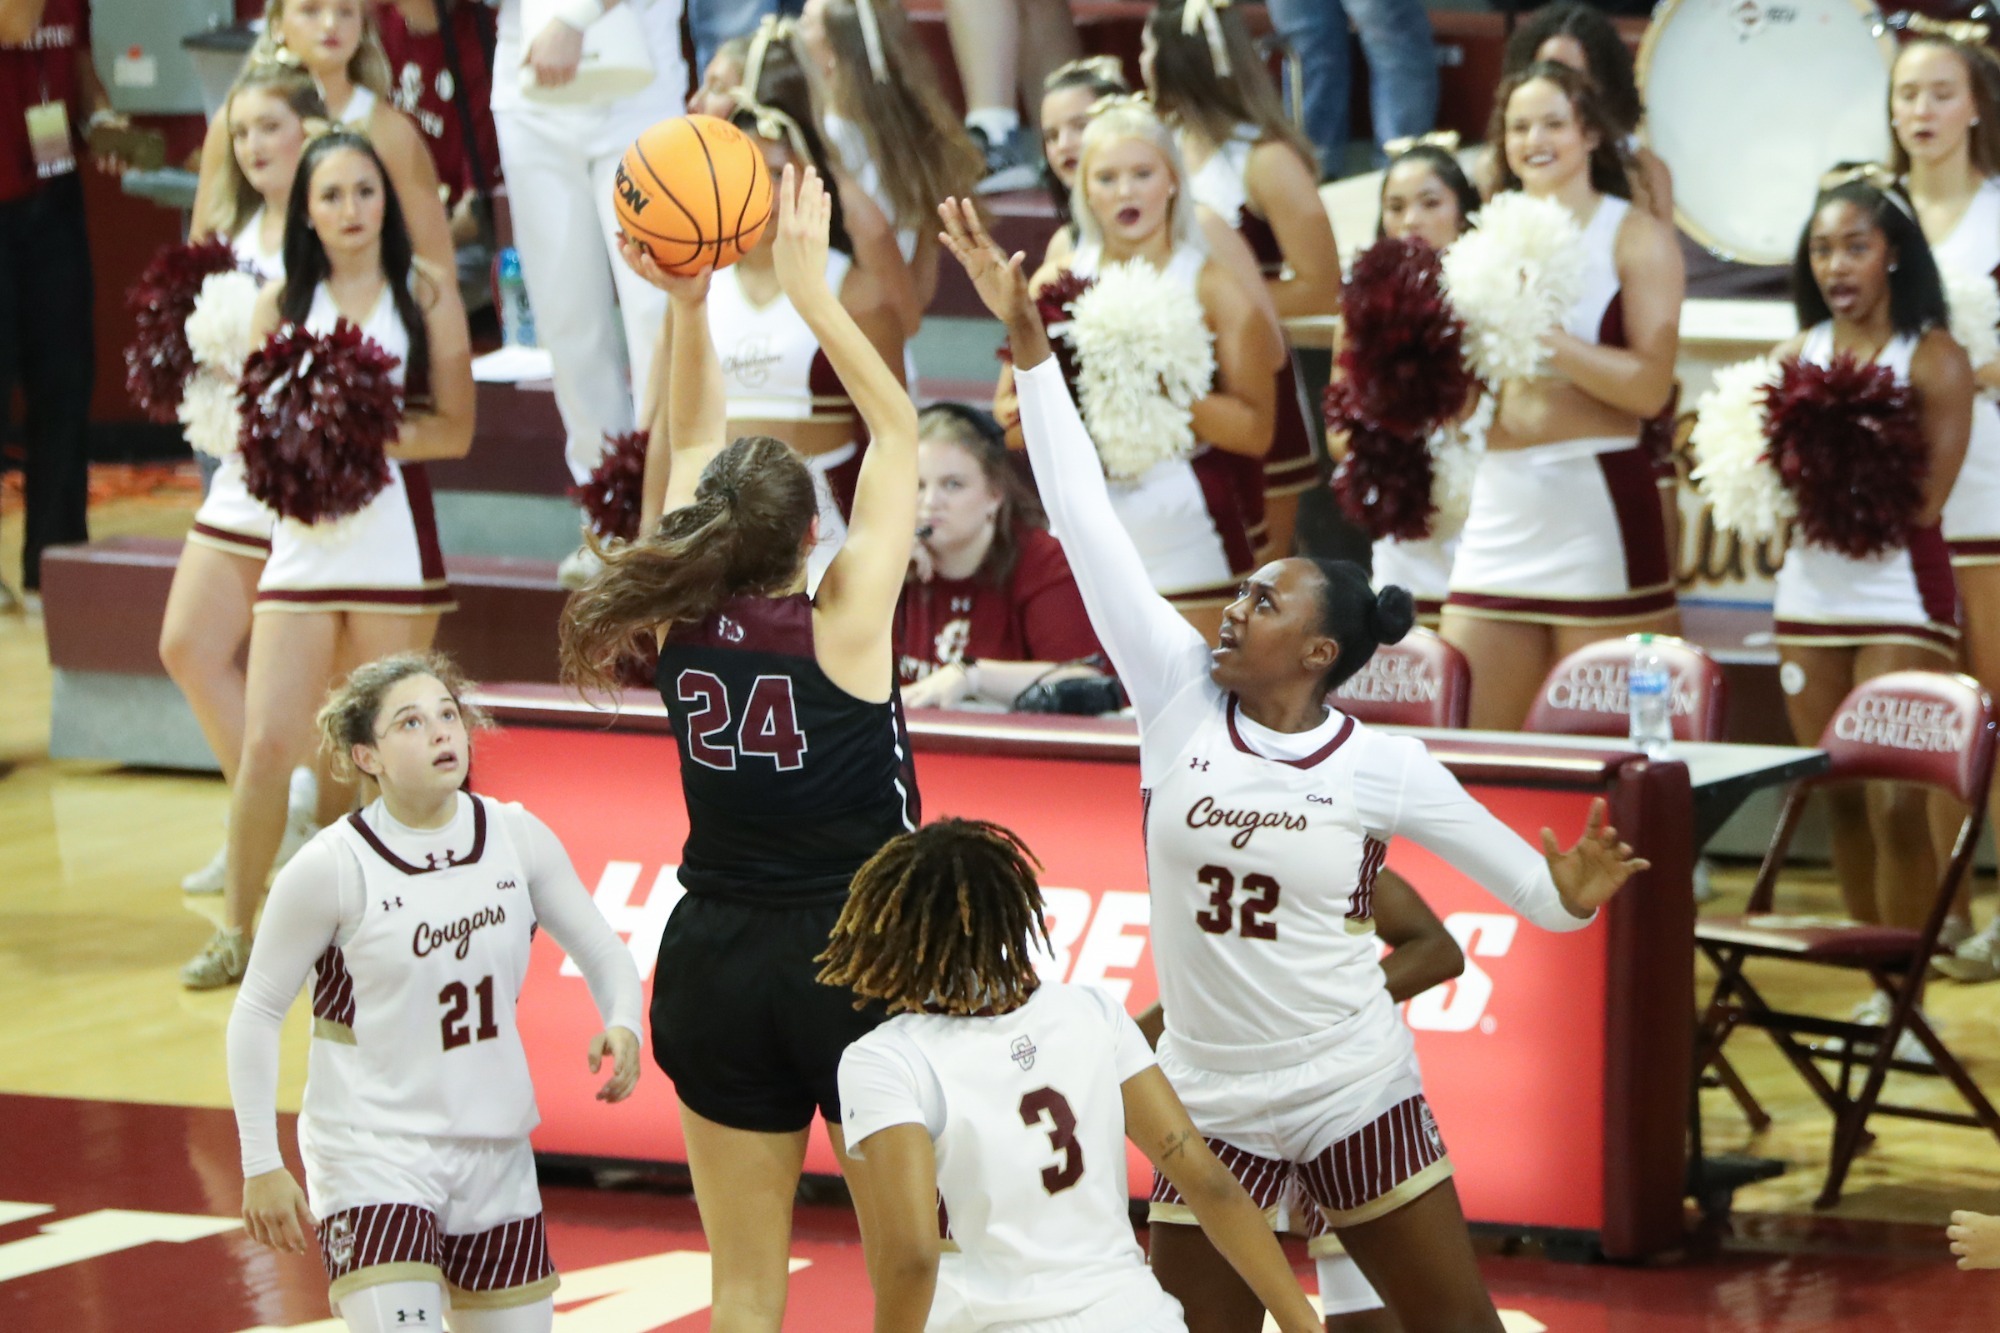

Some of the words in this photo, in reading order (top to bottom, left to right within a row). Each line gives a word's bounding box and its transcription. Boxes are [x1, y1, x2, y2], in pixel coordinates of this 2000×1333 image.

[677, 668, 808, 772] 24
[1834, 710, 1966, 754] CHARLESTON
[1857, 695, 1946, 727] COLLEGE
[1186, 796, 1307, 849] Cougars
[1306, 794, 1333, 805] CAA
[496, 880, 516, 890] CAA
[1196, 864, 1281, 941] 32
[412, 905, 506, 960] Cougars
[438, 974, 499, 1052] 21
[1018, 1083, 1086, 1198] 3
